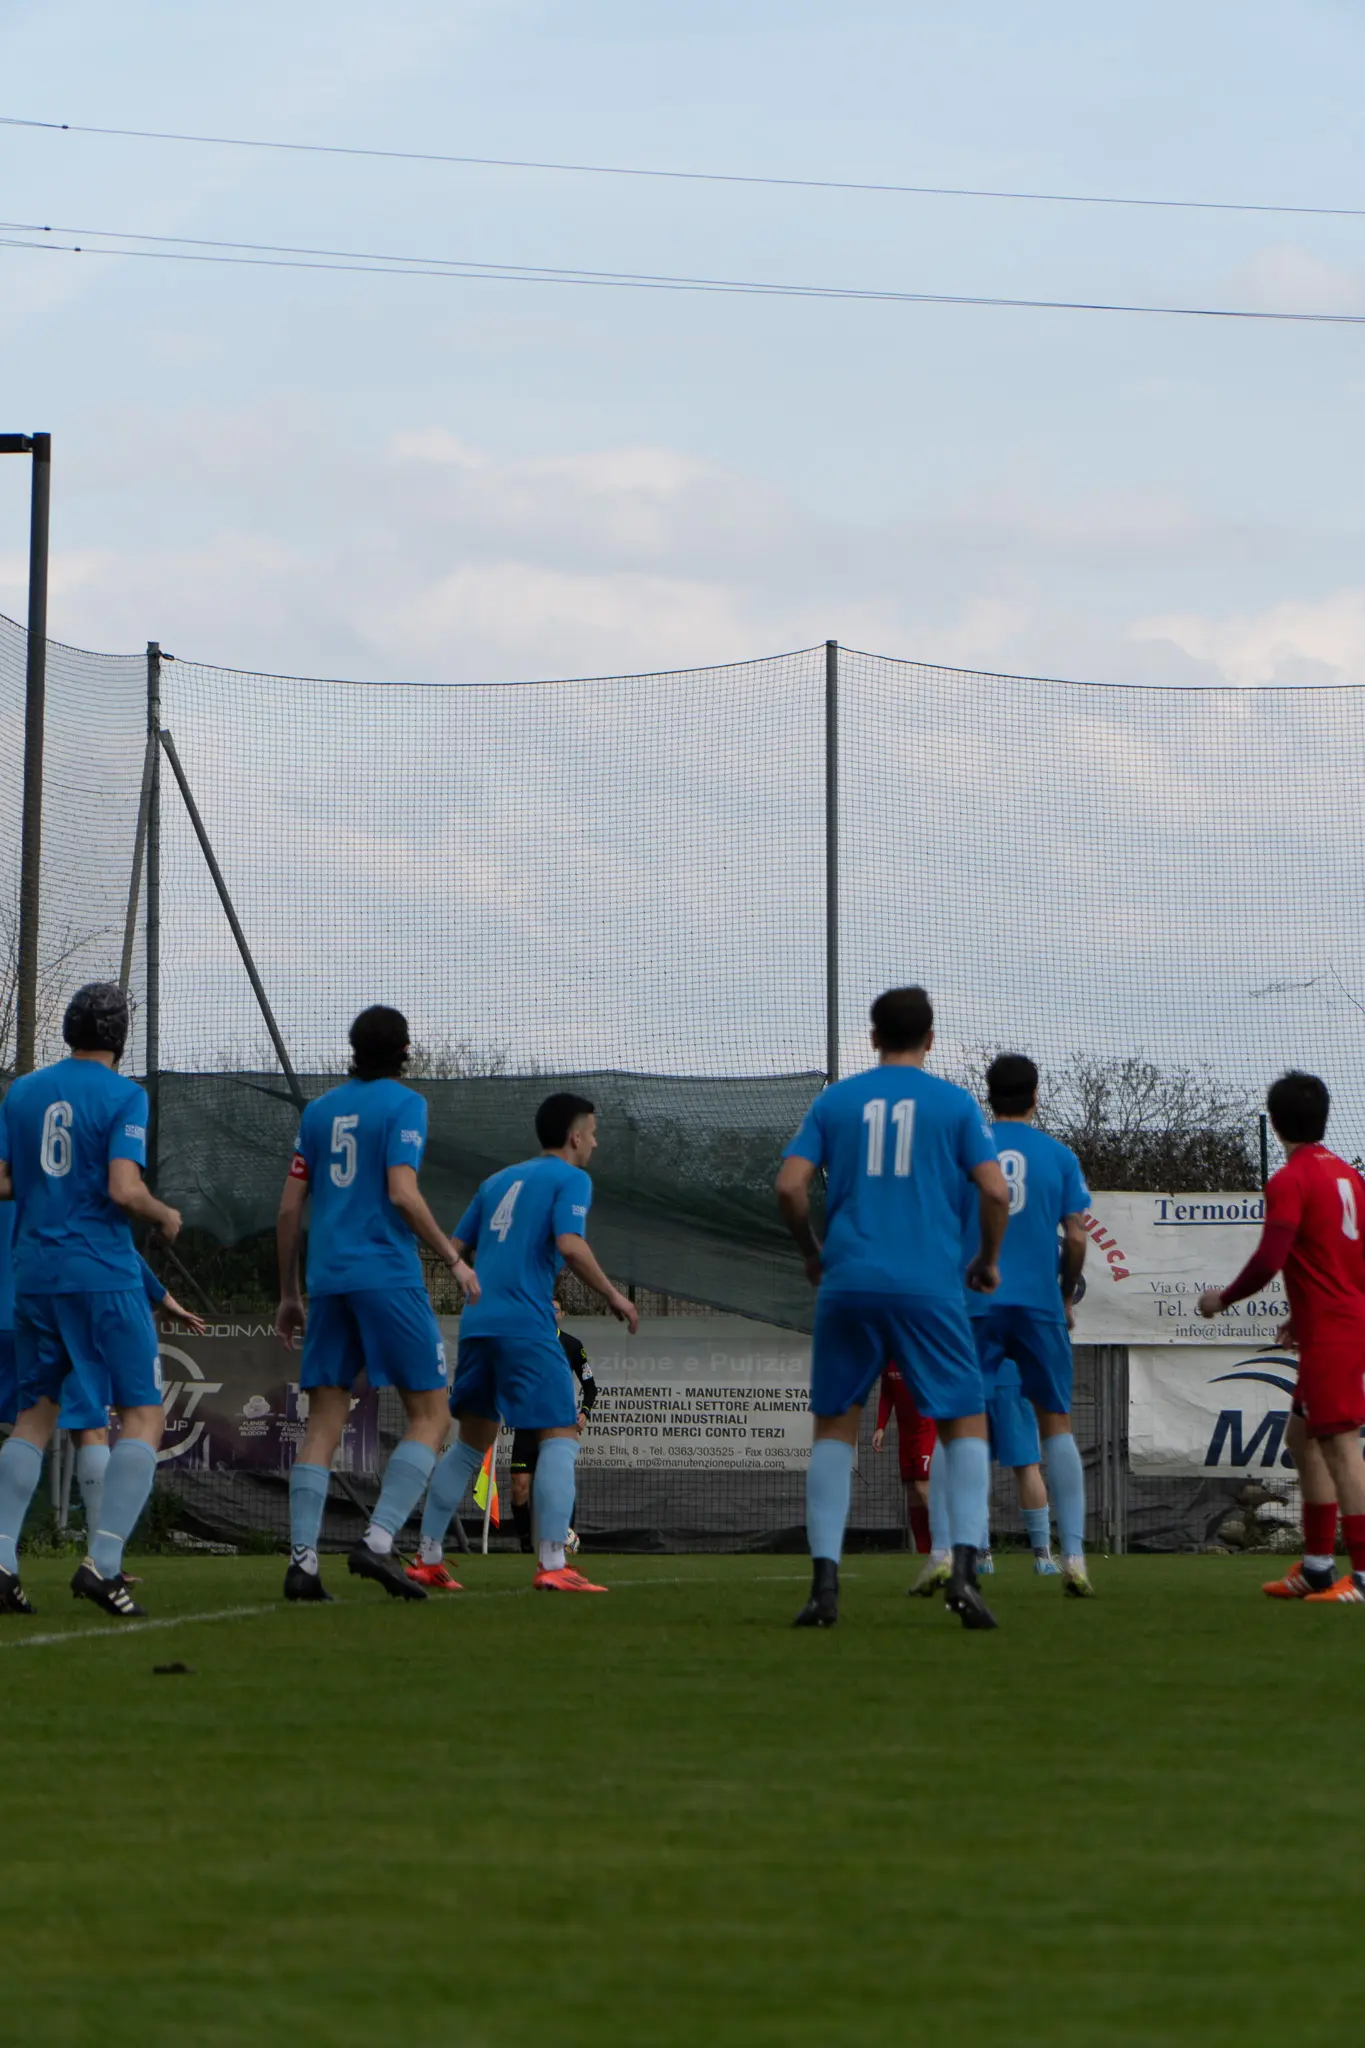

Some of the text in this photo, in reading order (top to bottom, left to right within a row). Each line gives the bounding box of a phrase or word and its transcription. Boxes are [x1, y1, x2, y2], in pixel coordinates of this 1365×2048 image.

[40, 1101, 73, 1177] 6
[863, 1099, 915, 1177] 11
[330, 1114, 359, 1187] 5
[998, 1149, 1026, 1216] 8
[490, 1180, 524, 1242] 4
[1083, 1213, 1130, 1282] ULICA
[1150, 1281, 1171, 1293] Via
[1175, 1281, 1189, 1293] G.
[1154, 1300, 1187, 1316] Tel.
[1246, 1300, 1290, 1316] 0363
[684, 1356, 699, 1371] e
[710, 1351, 804, 1372] Pulizia
[578, 1387, 672, 1398] APARTAMENTI
[685, 1388, 782, 1399] MANUTENZIONE
[614, 1400, 691, 1411] INDUSTRIALI
[695, 1401, 749, 1412] SETTORE
[671, 1414, 747, 1425] INDUSTRIALI
[587, 1426, 785, 1439] TRASPORTO MERCI CONTO TERZI
[579, 1447, 594, 1455] nte
[597, 1446, 607, 1455] S.
[649, 1446, 665, 1455] Tel.
[668, 1447, 734, 1457] 0363/303525
[745, 1447, 763, 1457] Fax
[922, 1455, 931, 1471] 7
